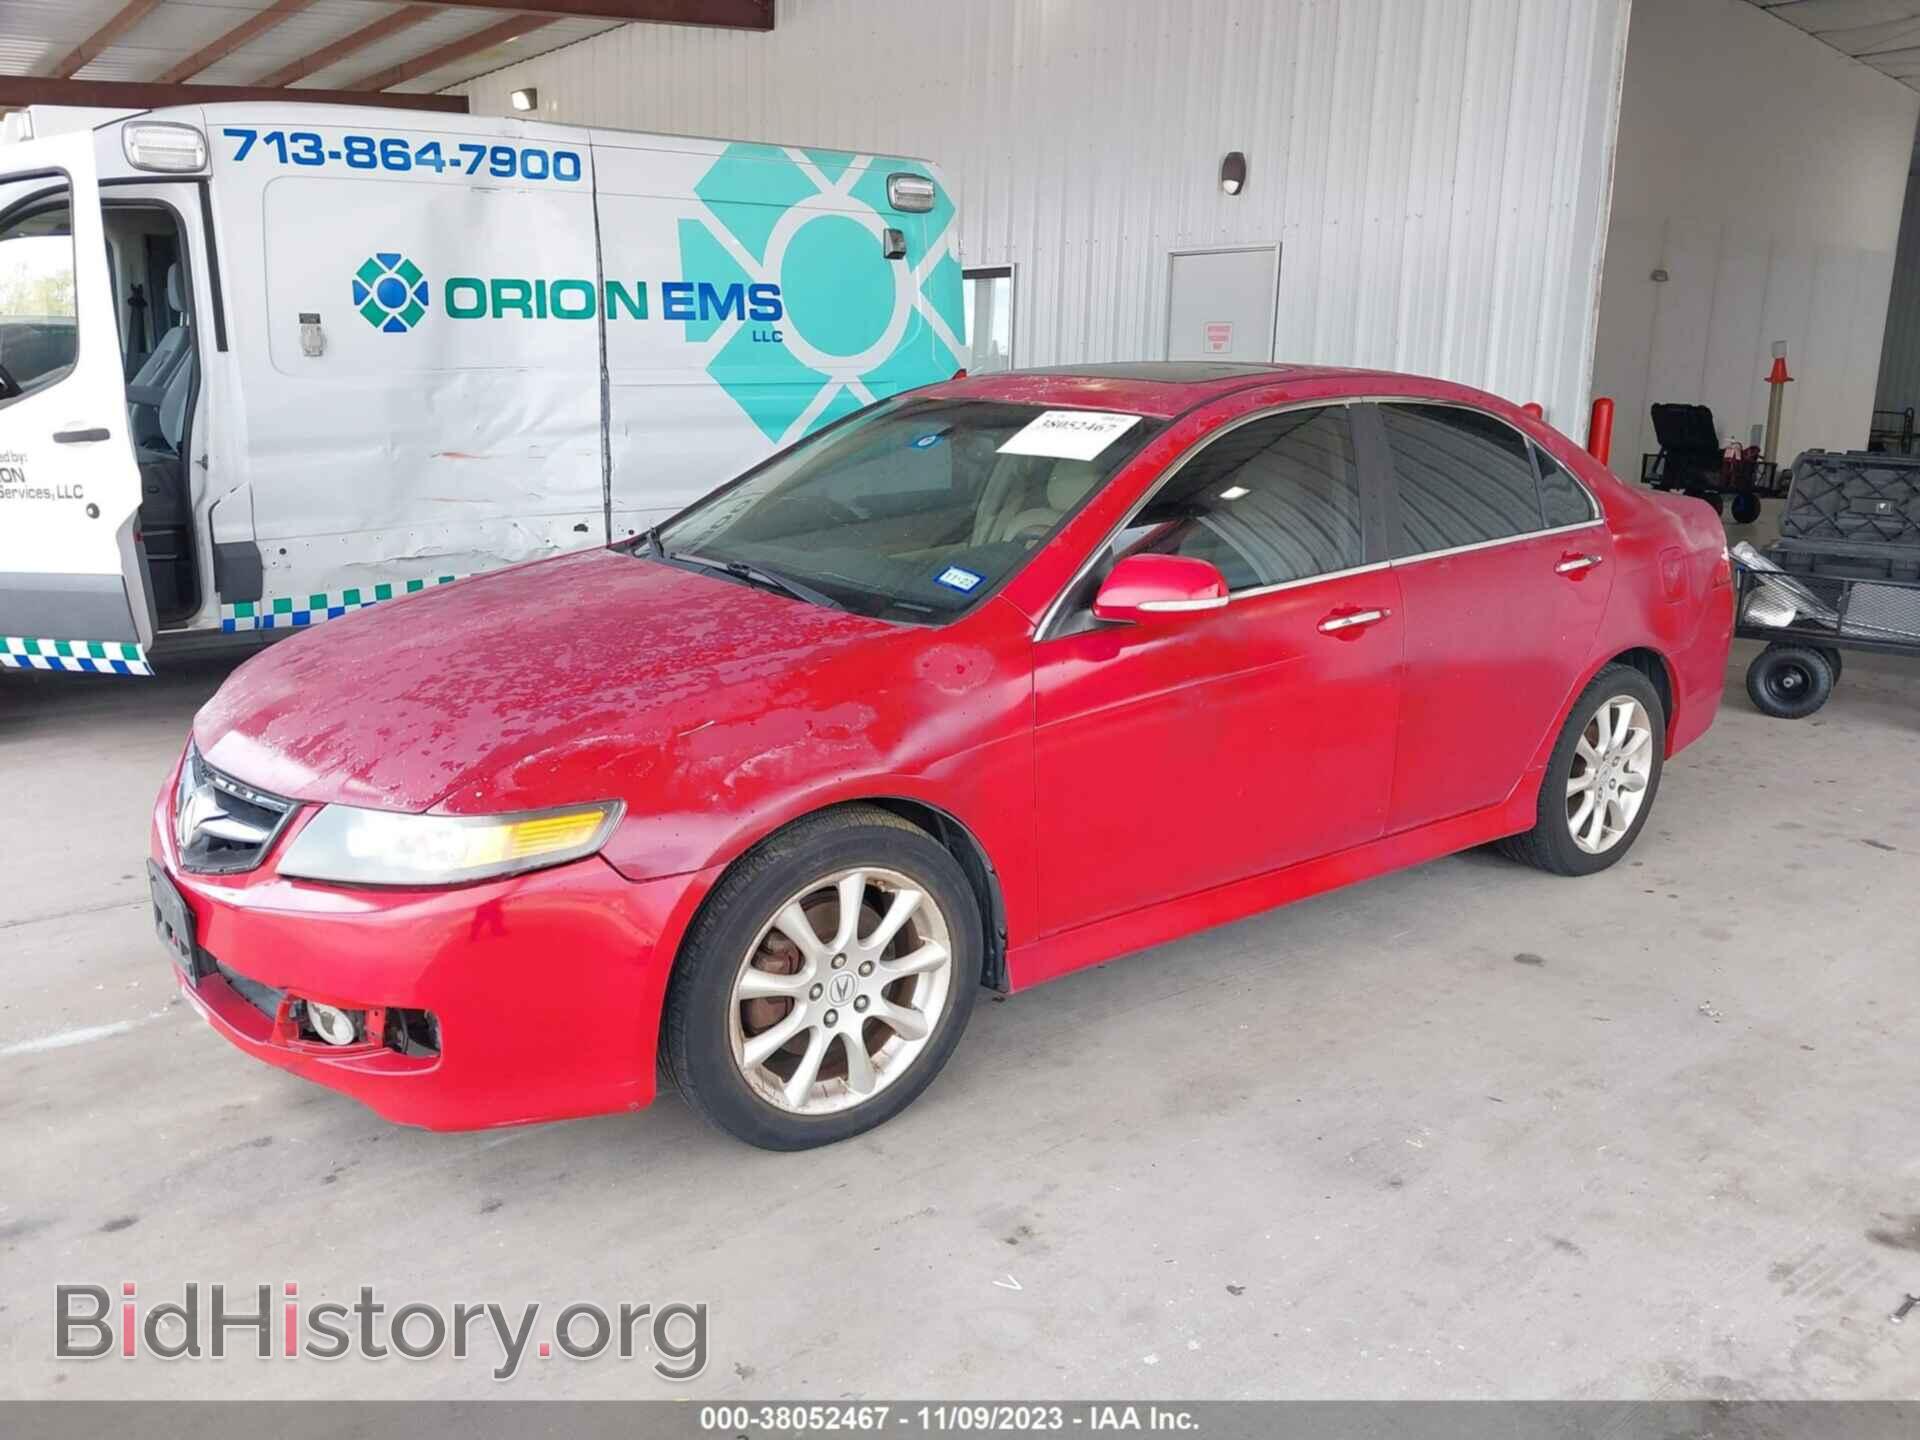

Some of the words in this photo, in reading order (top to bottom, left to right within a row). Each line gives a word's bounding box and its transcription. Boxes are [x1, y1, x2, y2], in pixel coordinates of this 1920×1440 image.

[222, 128, 582, 182] 713-864-7900
[444, 277, 649, 320] ORION
[661, 281, 784, 322] EMS
[752, 330, 784, 343] LLC
[56, 484, 84, 499] LLC
